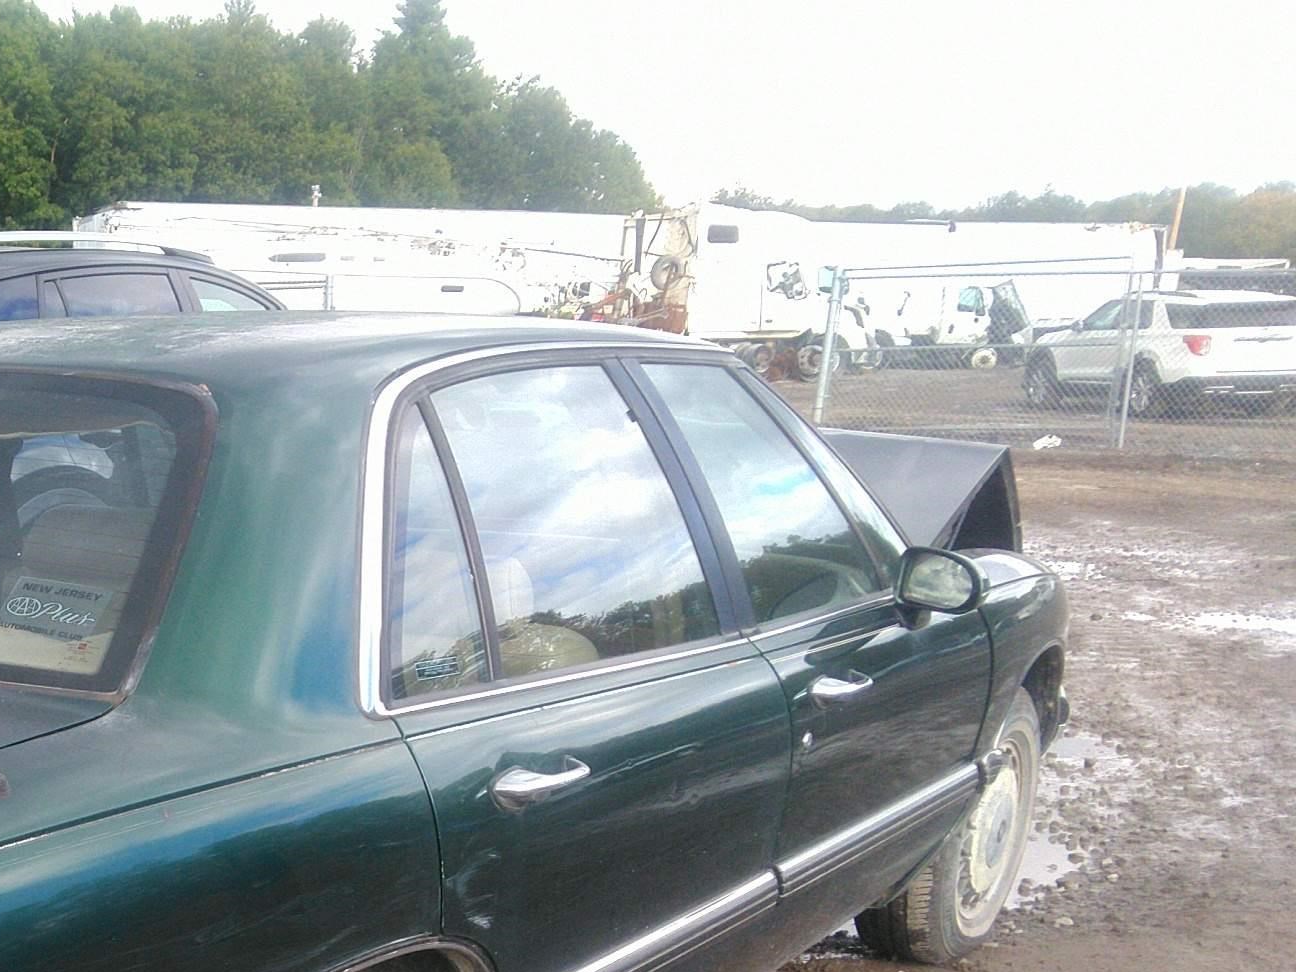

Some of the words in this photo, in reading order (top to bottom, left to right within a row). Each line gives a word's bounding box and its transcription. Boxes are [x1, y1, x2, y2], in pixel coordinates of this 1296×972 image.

[22, 583, 53, 595] NEW
[54, 587, 103, 601] JERSEY
[31, 602, 96, 625] Plus
[58, 631, 83, 641] CLUB
